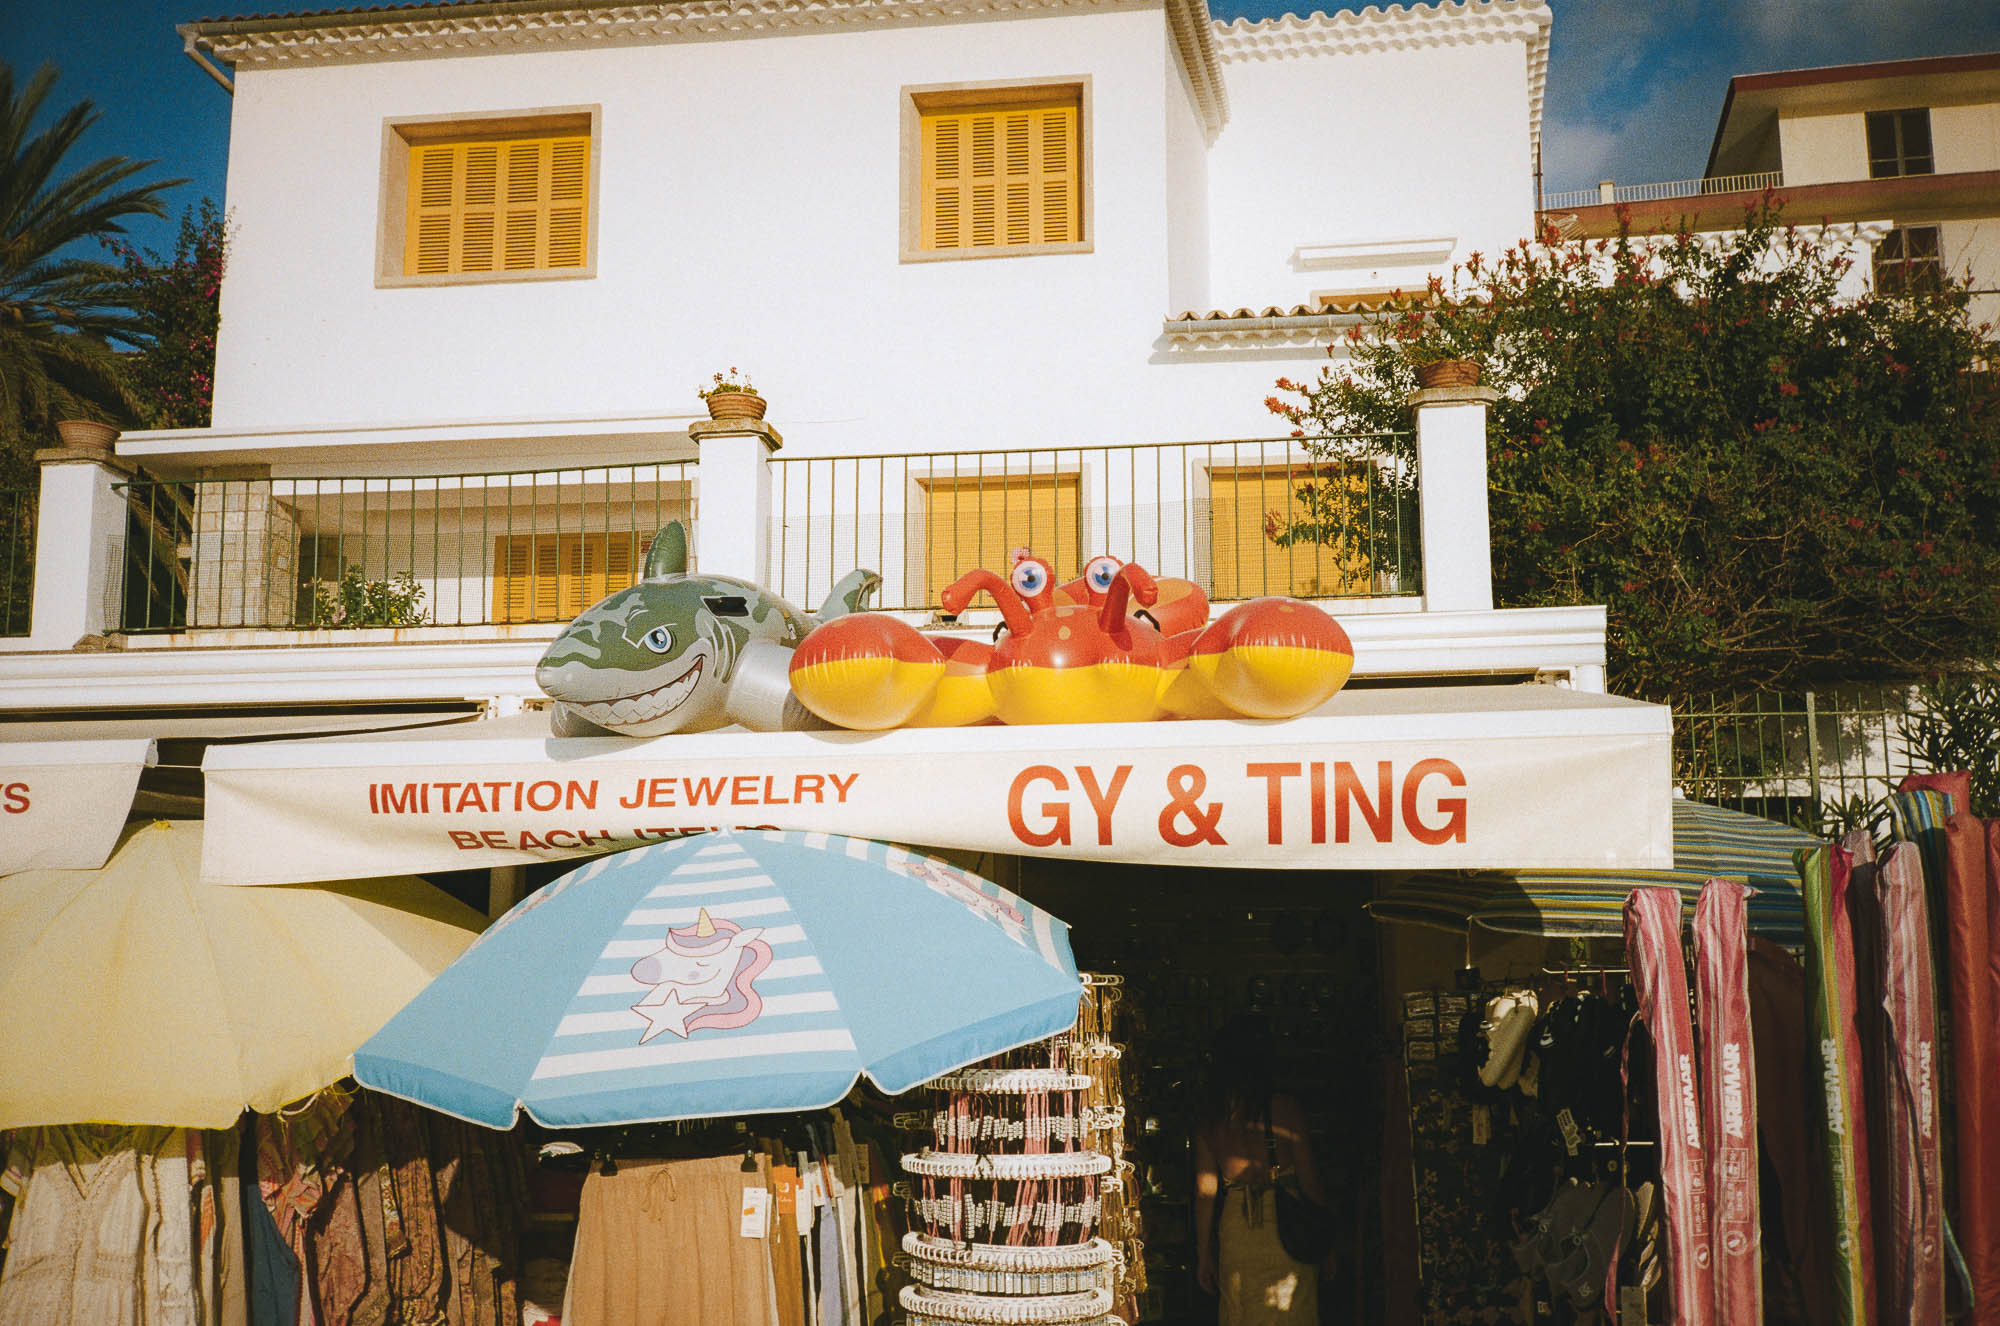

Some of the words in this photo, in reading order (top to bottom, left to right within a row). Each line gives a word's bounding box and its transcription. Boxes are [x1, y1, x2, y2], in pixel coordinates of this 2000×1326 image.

[0, 782, 31, 814] S
[369, 780, 599, 815] IMITATION
[619, 773, 859, 809] JEWELRY
[447, 829, 618, 851] BEACH
[1007, 765, 1133, 848] GY
[1158, 764, 1228, 848] &
[1246, 758, 1467, 846] TING
[1679, 1053, 1700, 1149] AREMAR
[1723, 1042, 1744, 1139] AREMAR
[1821, 1038, 1845, 1135] AREMAR
[1920, 1041, 1932, 1138] AREMAR
